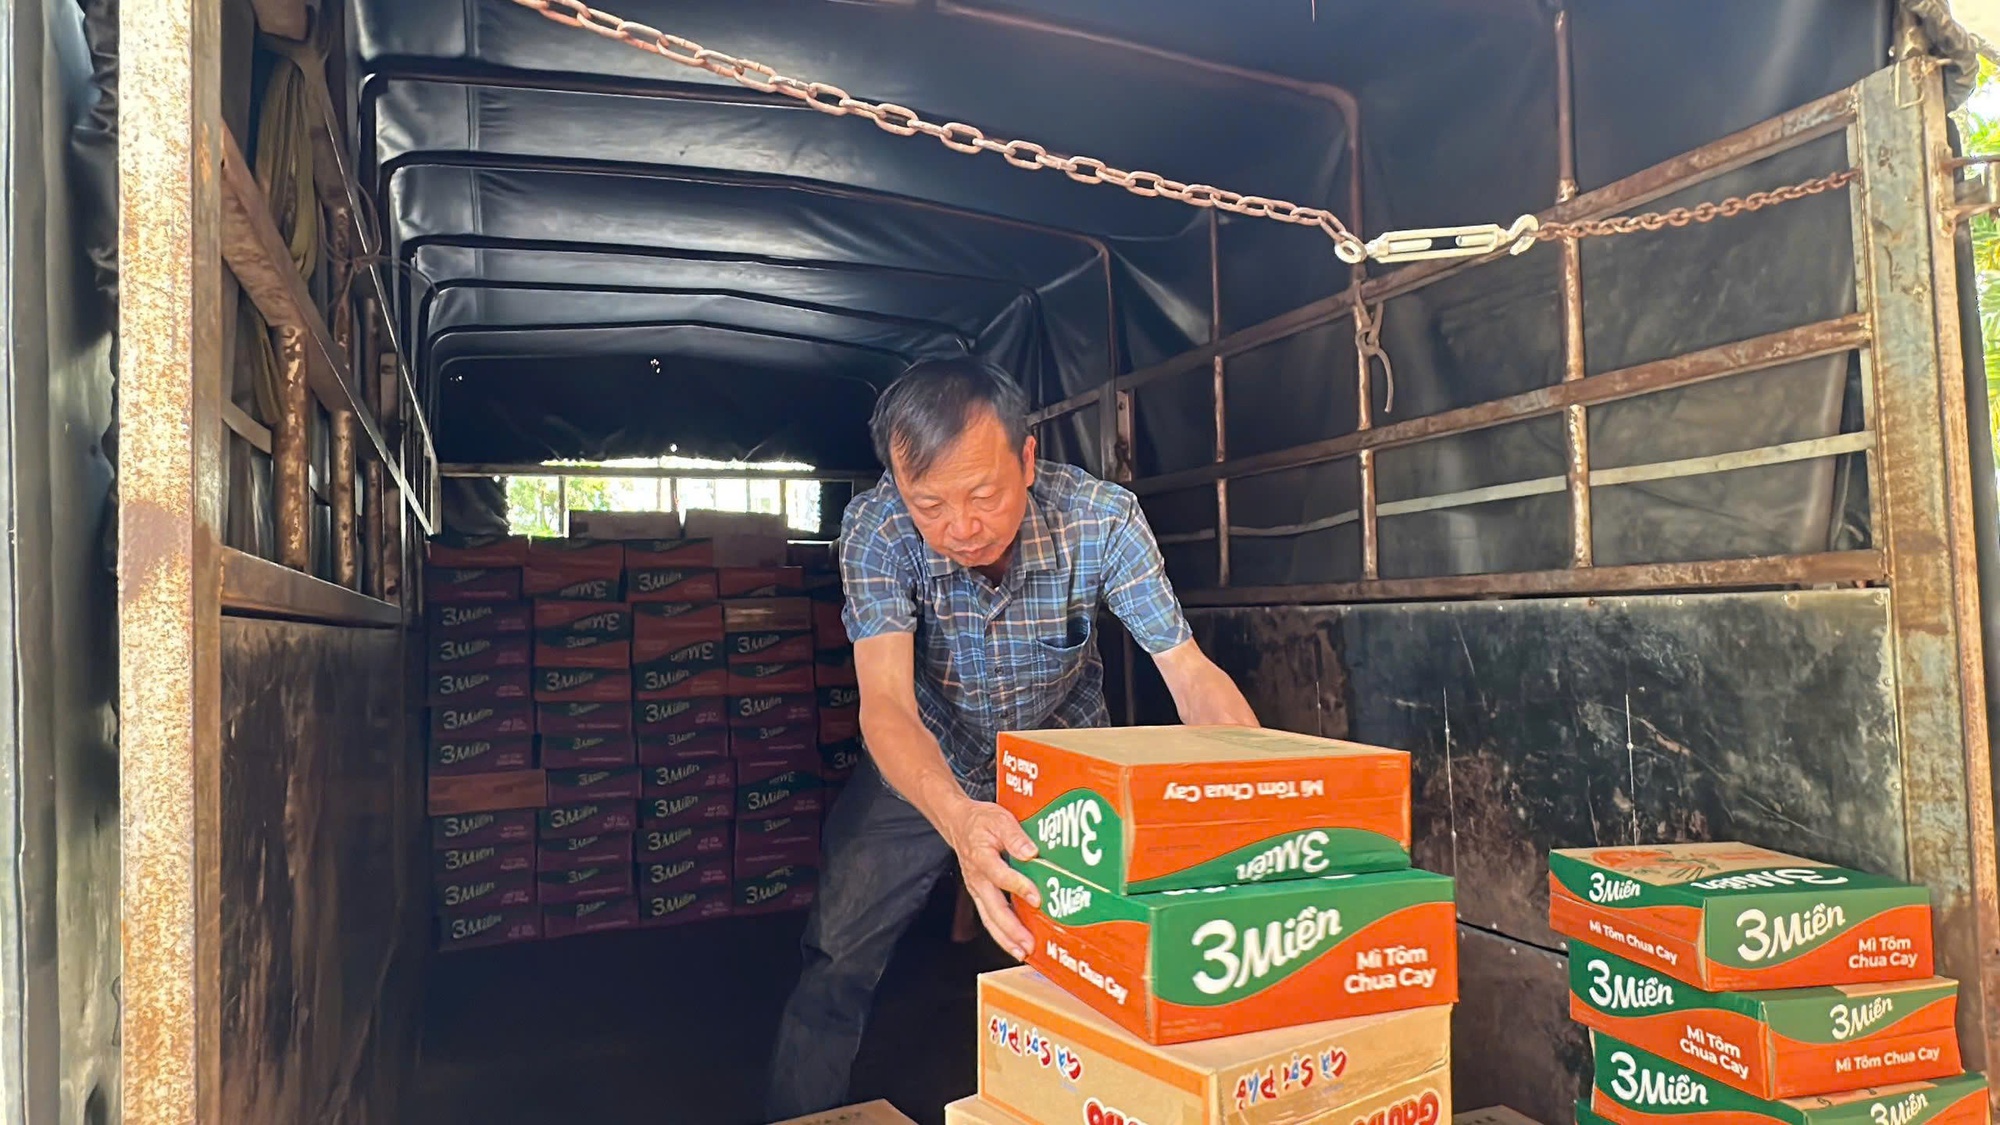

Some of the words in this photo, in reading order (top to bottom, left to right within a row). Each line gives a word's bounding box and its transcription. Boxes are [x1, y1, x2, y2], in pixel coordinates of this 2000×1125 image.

[1164, 782, 1200, 802] Cay
[1204, 783, 1254, 800] Chua
[1626, 933, 1655, 955] Chua
[1656, 944, 1679, 966] Cay
[1878, 935, 1912, 950] Tôm
[1386, 944, 1428, 966] Tôm
[1849, 952, 1888, 969] Chua
[1889, 952, 1919, 969] Cay
[1344, 970, 1398, 995] Chua
[1398, 967, 1438, 989] Cay
[1706, 1030, 1741, 1059] Tôm
[1680, 1038, 1718, 1066] Chua
[1720, 1053, 1749, 1080] Cay
[1883, 1051, 1916, 1067] Chua
[1917, 1047, 1941, 1062] Cay
